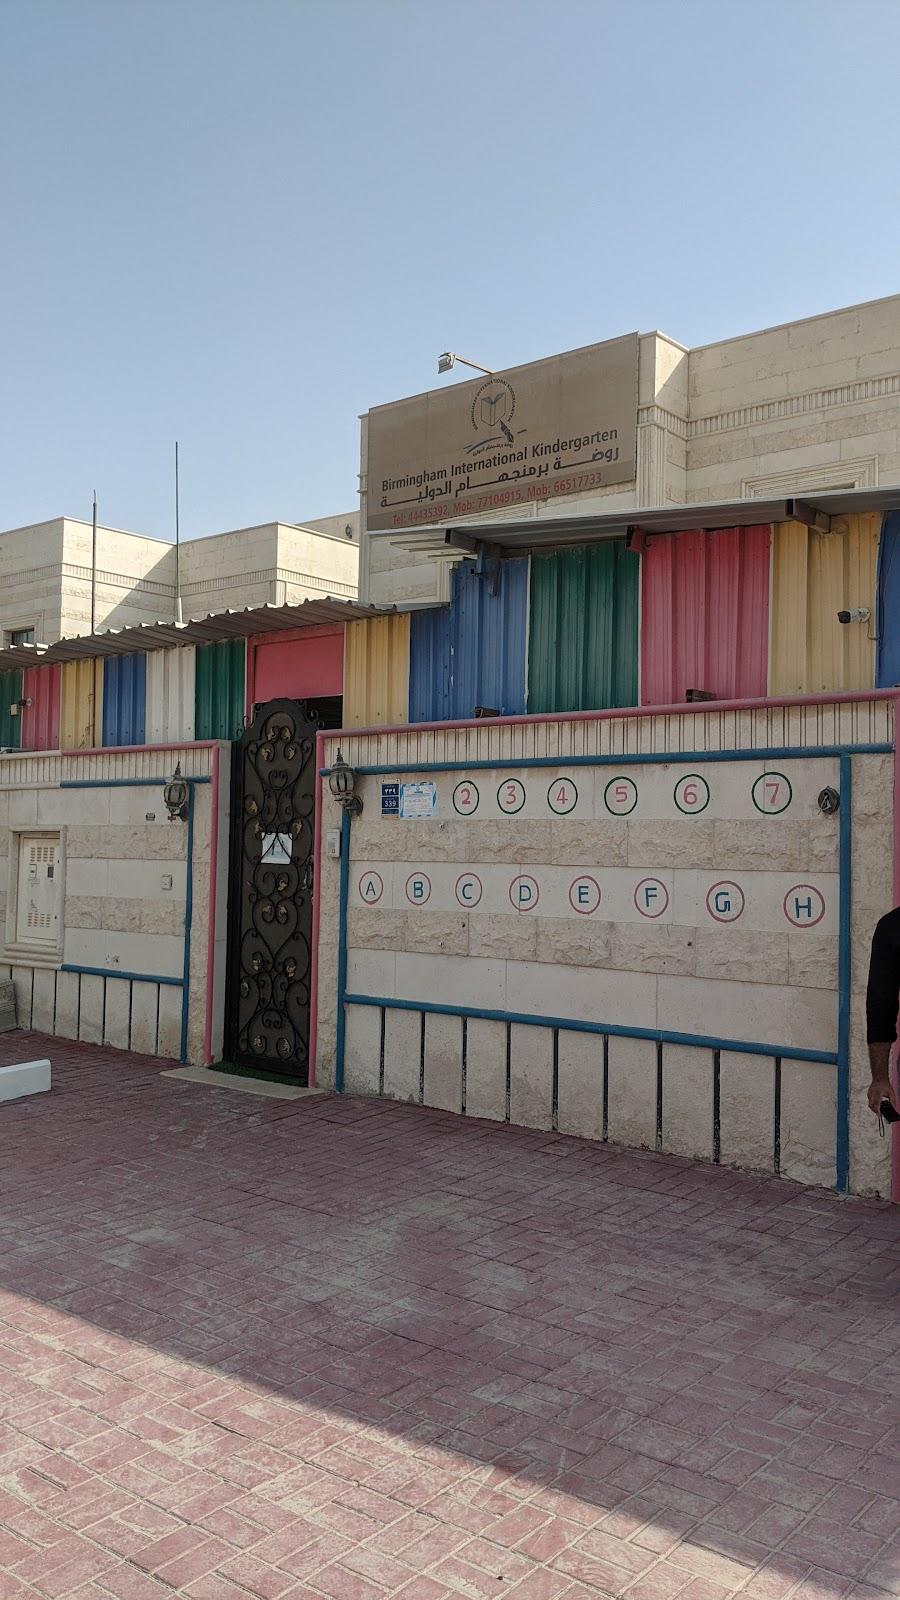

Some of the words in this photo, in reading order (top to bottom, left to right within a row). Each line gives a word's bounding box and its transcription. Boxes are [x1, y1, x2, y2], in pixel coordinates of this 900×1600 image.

[382, 469, 447, 492] Birmingham
[451, 446, 527, 477] International
[532, 429, 618, 458] Kindergarten
[553, 447, 619, 470] روضة
[380, 480, 452, 507] الدولية
[455, 461, 550, 498] برمنجهام
[392, 514, 406, 526] Tel:
[453, 499, 475, 513] Mob:
[527, 483, 551, 500] Mob:
[554, 472, 602, 492] 66517733
[384, 799, 397, 808] 339
[461, 788, 472, 806] 2
[506, 785, 517, 805] 3
[556, 786, 569, 805] 4
[615, 786, 629, 803] 5
[683, 784, 699, 806] 6
[765, 783, 780, 805] 7
[365, 880, 376, 896] A
[413, 881, 424, 898] B
[461, 883, 473, 900] C
[519, 884, 532, 902] D
[578, 885, 590, 903] E
[645, 887, 658, 907] F
[714, 891, 731, 913] G
[794, 897, 812, 919] H
